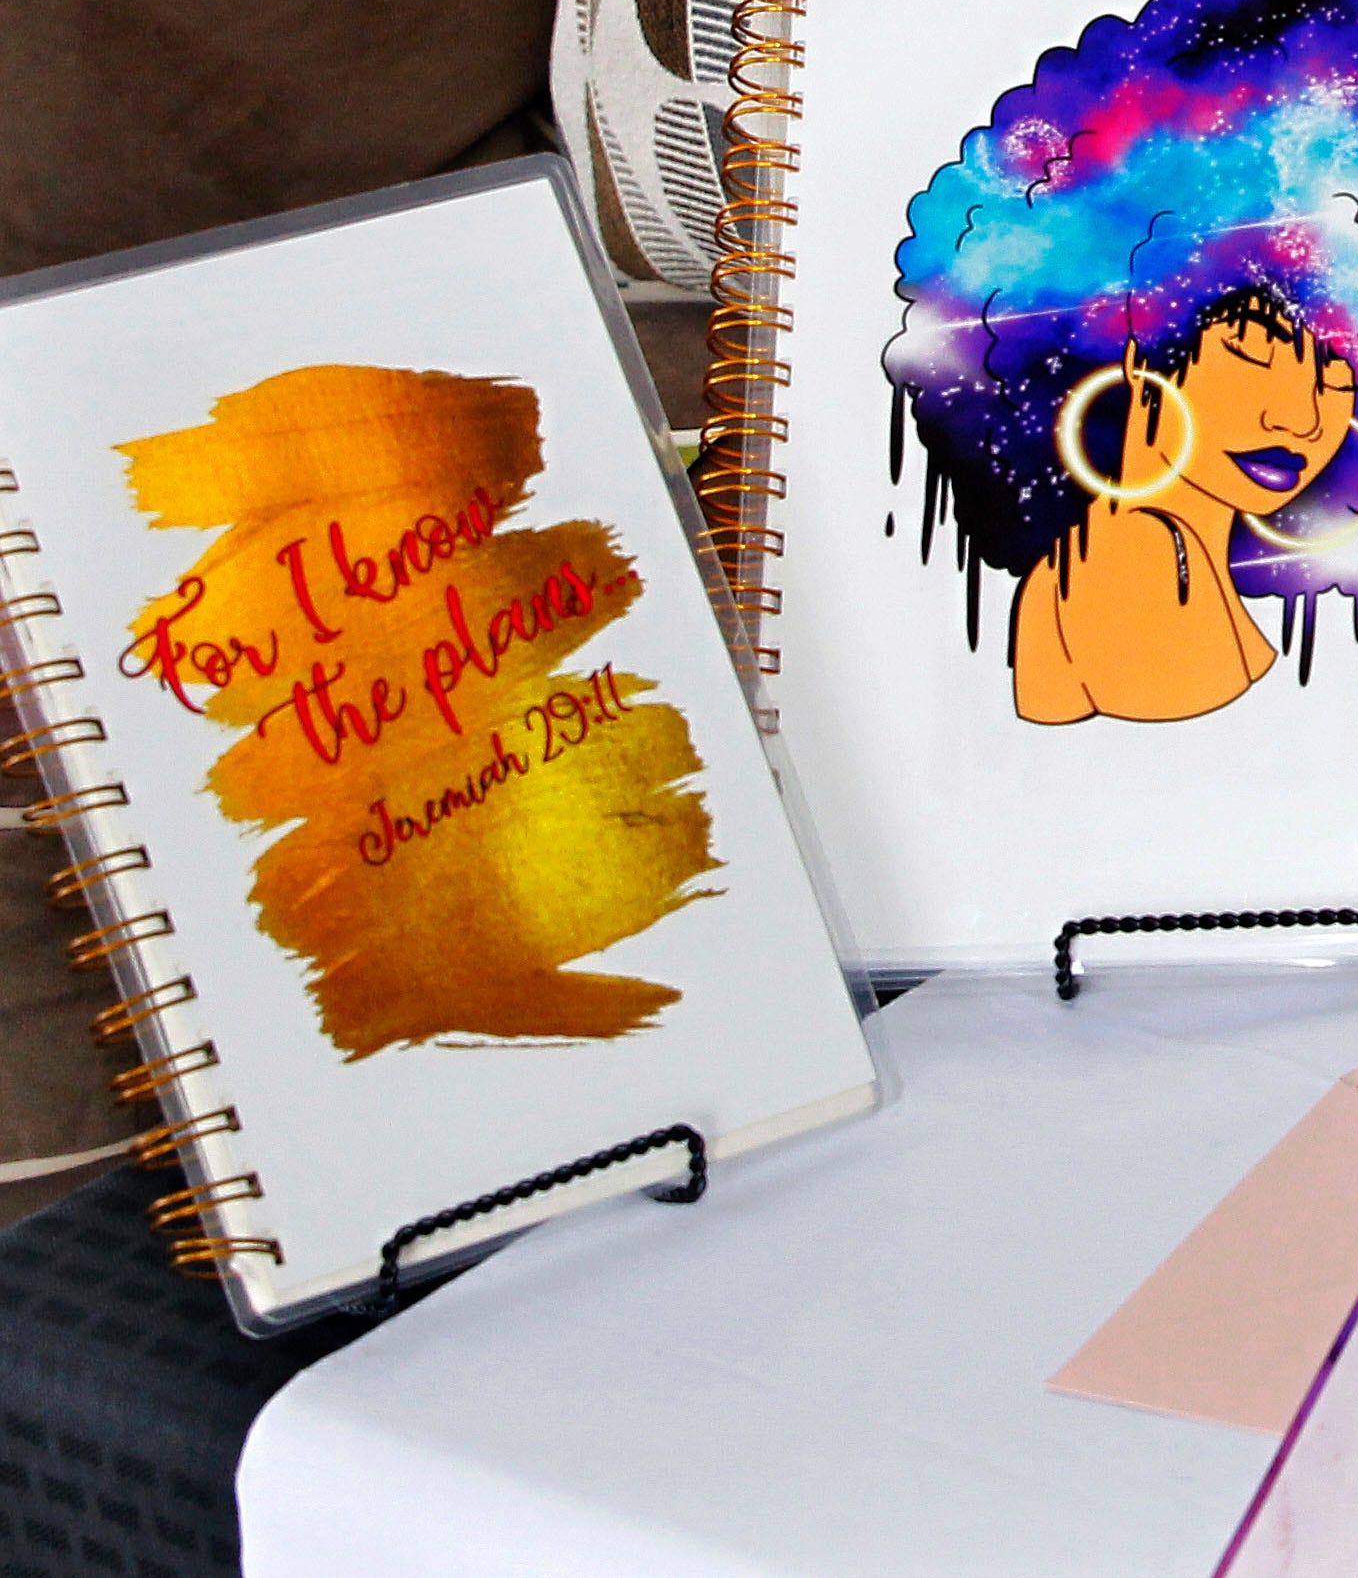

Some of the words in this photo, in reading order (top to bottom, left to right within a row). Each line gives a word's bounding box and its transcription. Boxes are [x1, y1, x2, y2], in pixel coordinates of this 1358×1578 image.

[119, 576, 277, 714] For
[277, 539, 342, 642] I
[329, 487, 503, 602] know
[258, 661, 406, 764] the
[358, 732, 530, 865] Jeremiah
[525, 662, 633, 763] 29:11
